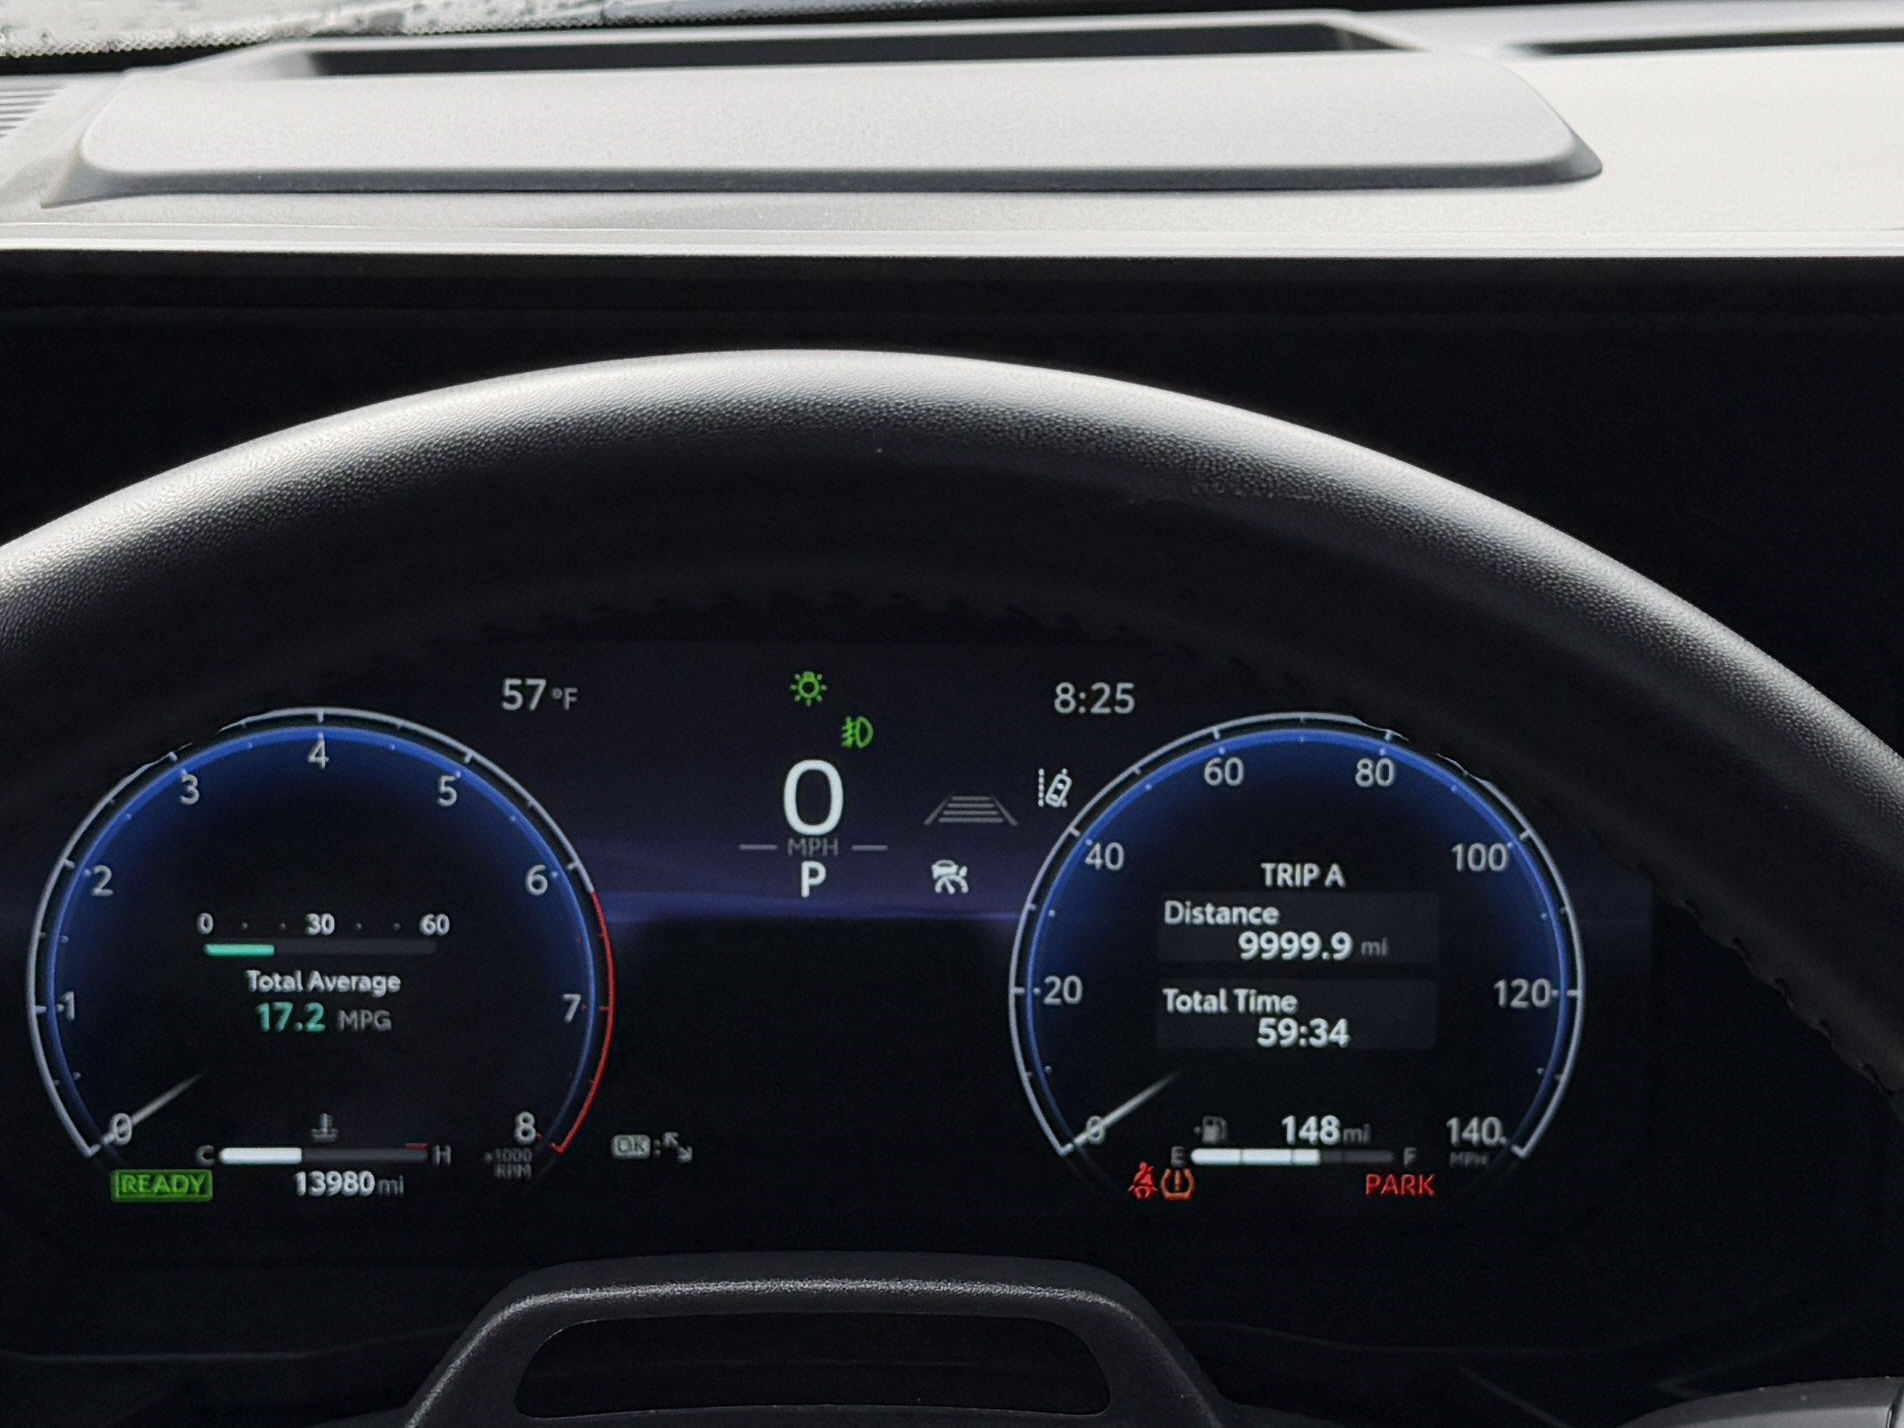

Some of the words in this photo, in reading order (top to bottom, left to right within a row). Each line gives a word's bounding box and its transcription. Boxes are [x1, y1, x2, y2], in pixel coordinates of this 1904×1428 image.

[503, 679, 546, 710] 57
[1055, 682, 1134, 714] 8:25
[307, 742, 328, 769] 4
[1204, 760, 1244, 786] 60
[1356, 760, 1396, 786] 80
[180, 775, 200, 803] 3
[437, 778, 458, 806] 5
[783, 759, 845, 836] 0
[788, 838, 838, 856] MPH
[1085, 844, 1124, 870] 40
[1452, 843, 1508, 871] 100
[91, 866, 113, 896] 2
[525, 864, 548, 895] 6
[802, 861, 826, 897] P
[1261, 863, 1319, 886] TRIP
[1325, 864, 1345, 886] A
[199, 913, 213, 933] 0
[307, 914, 335, 935] 30
[421, 914, 449, 935] 60
[1165, 901, 1279, 925] Distance
[1239, 931, 1352, 960] 9999.9
[1361, 938, 1388, 955] mi
[247, 970, 303, 992] Total
[308, 971, 400, 997] Average
[1043, 977, 1082, 1005] 20
[1494, 979, 1550, 1007] 120
[563, 994, 582, 1023] 7
[1163, 988, 1227, 1013] Total
[1234, 989, 1297, 1013] Time
[258, 1002, 325, 1031] 17.2
[339, 1010, 391, 1030] MPG
[1257, 1018, 1349, 1047] 59:34
[110, 1113, 132, 1143] 0
[515, 1113, 537, 1142] 8
[1447, 1117, 1501, 1144] 140
[196, 1145, 213, 1166] C
[432, 1146, 452, 1166] H
[1171, 1147, 1184, 1165] E
[1403, 1148, 1416, 1166] F
[120, 1174, 208, 1196] READY
[1366, 1174, 1434, 1195] PARK
